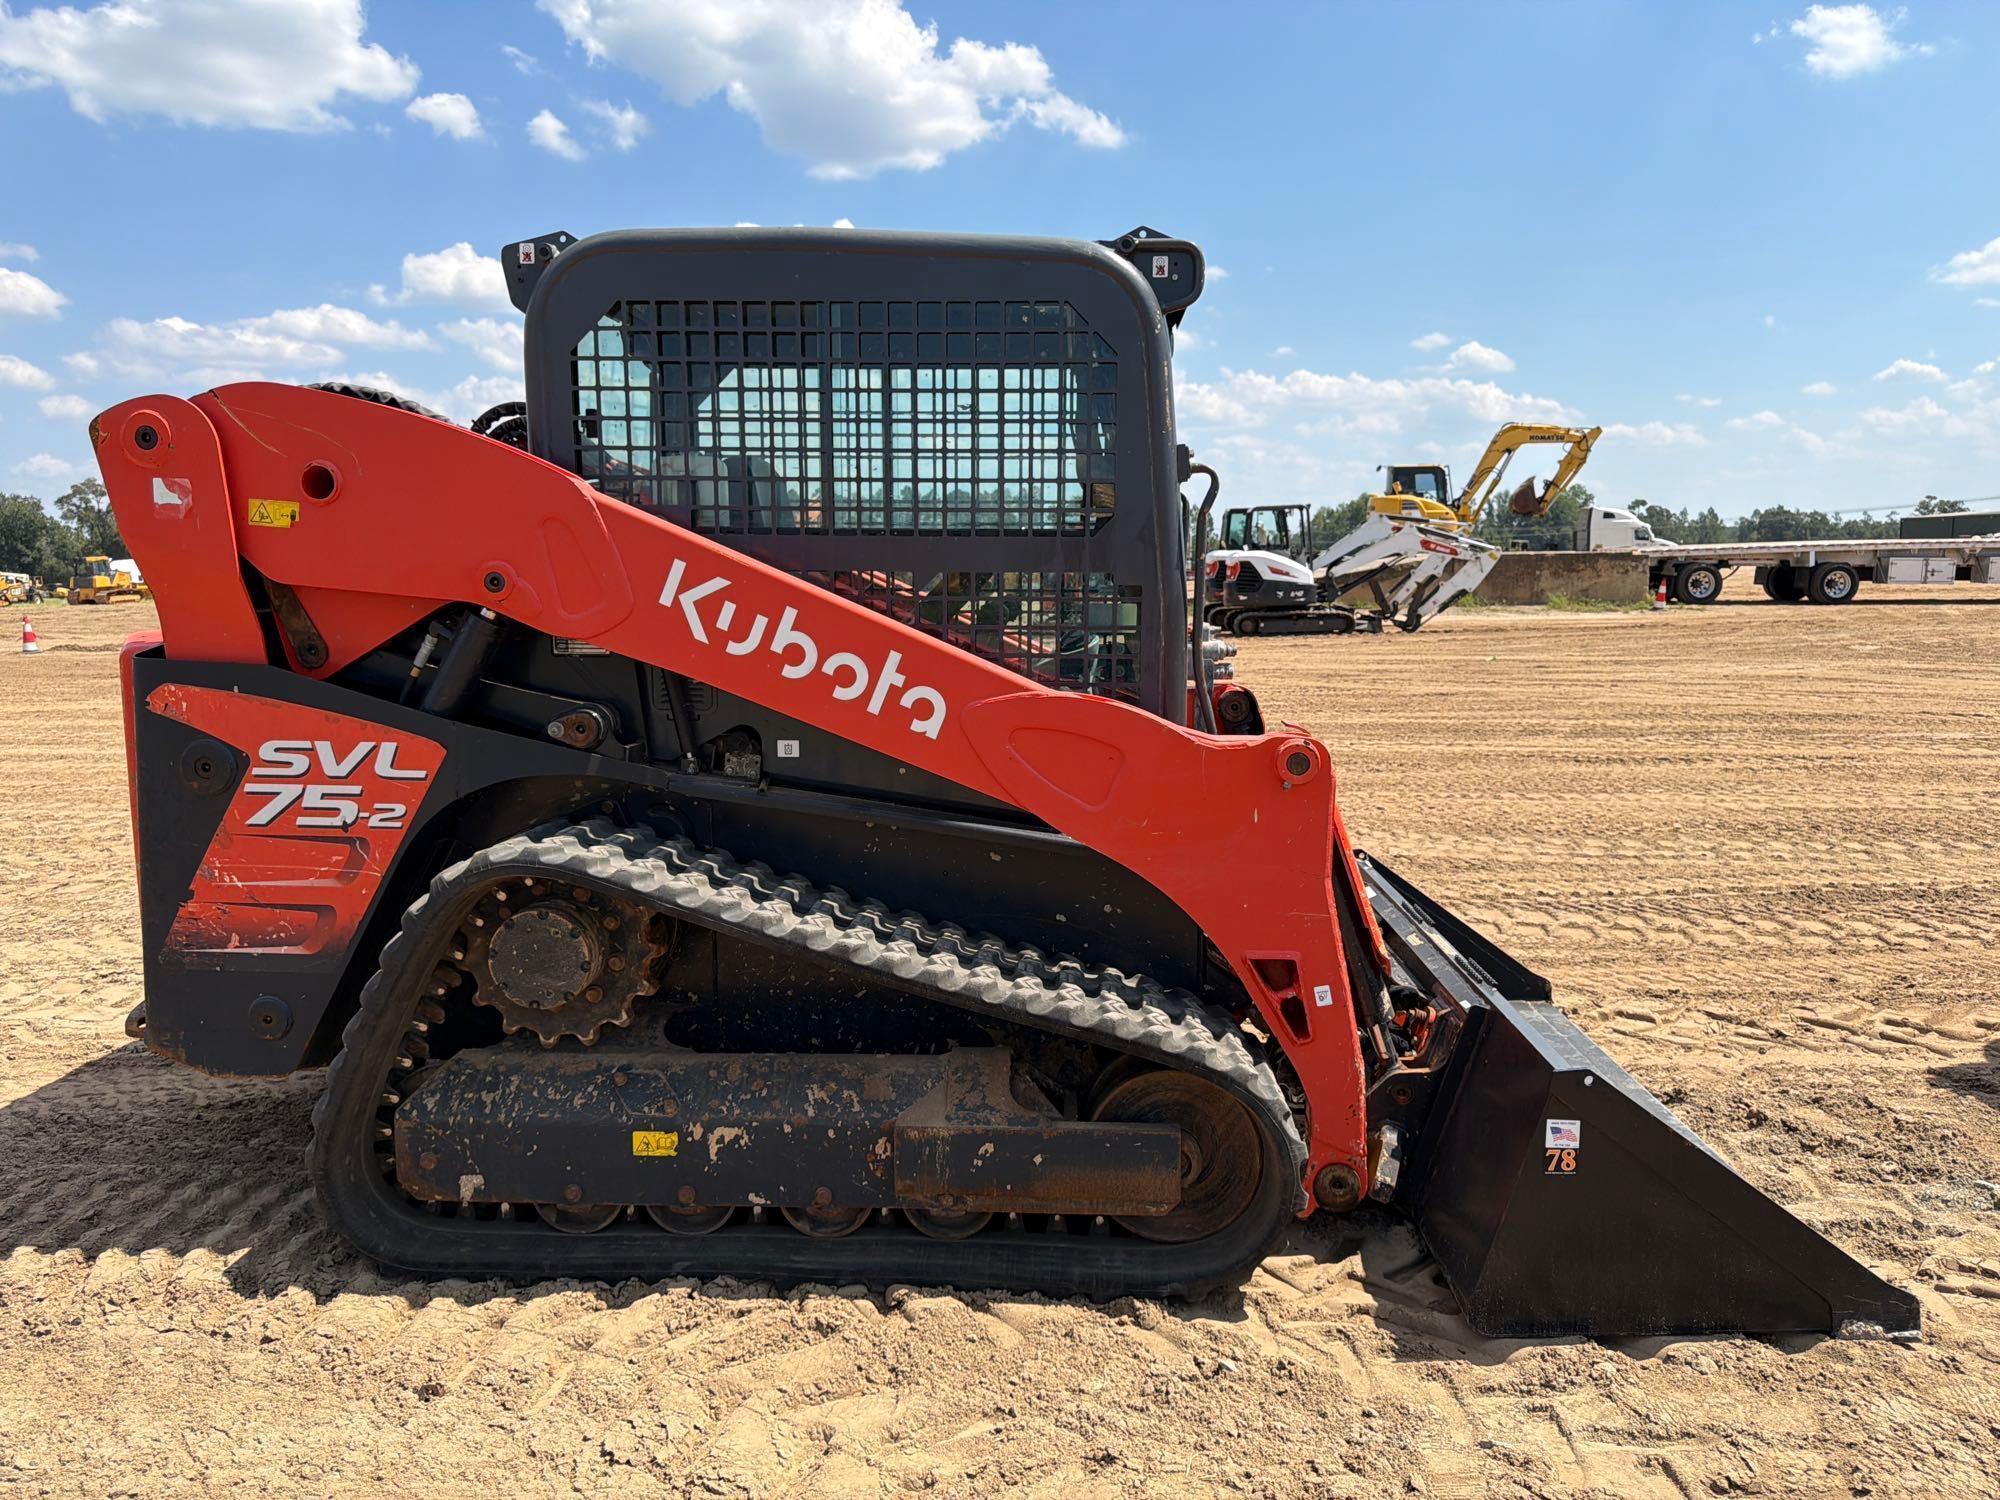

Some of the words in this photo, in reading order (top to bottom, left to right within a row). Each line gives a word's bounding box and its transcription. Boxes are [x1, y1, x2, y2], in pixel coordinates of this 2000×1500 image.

[658, 558, 947, 740] Kubota
[251, 740, 429, 781] SVL
[1545, 1148, 1577, 1172] 78
